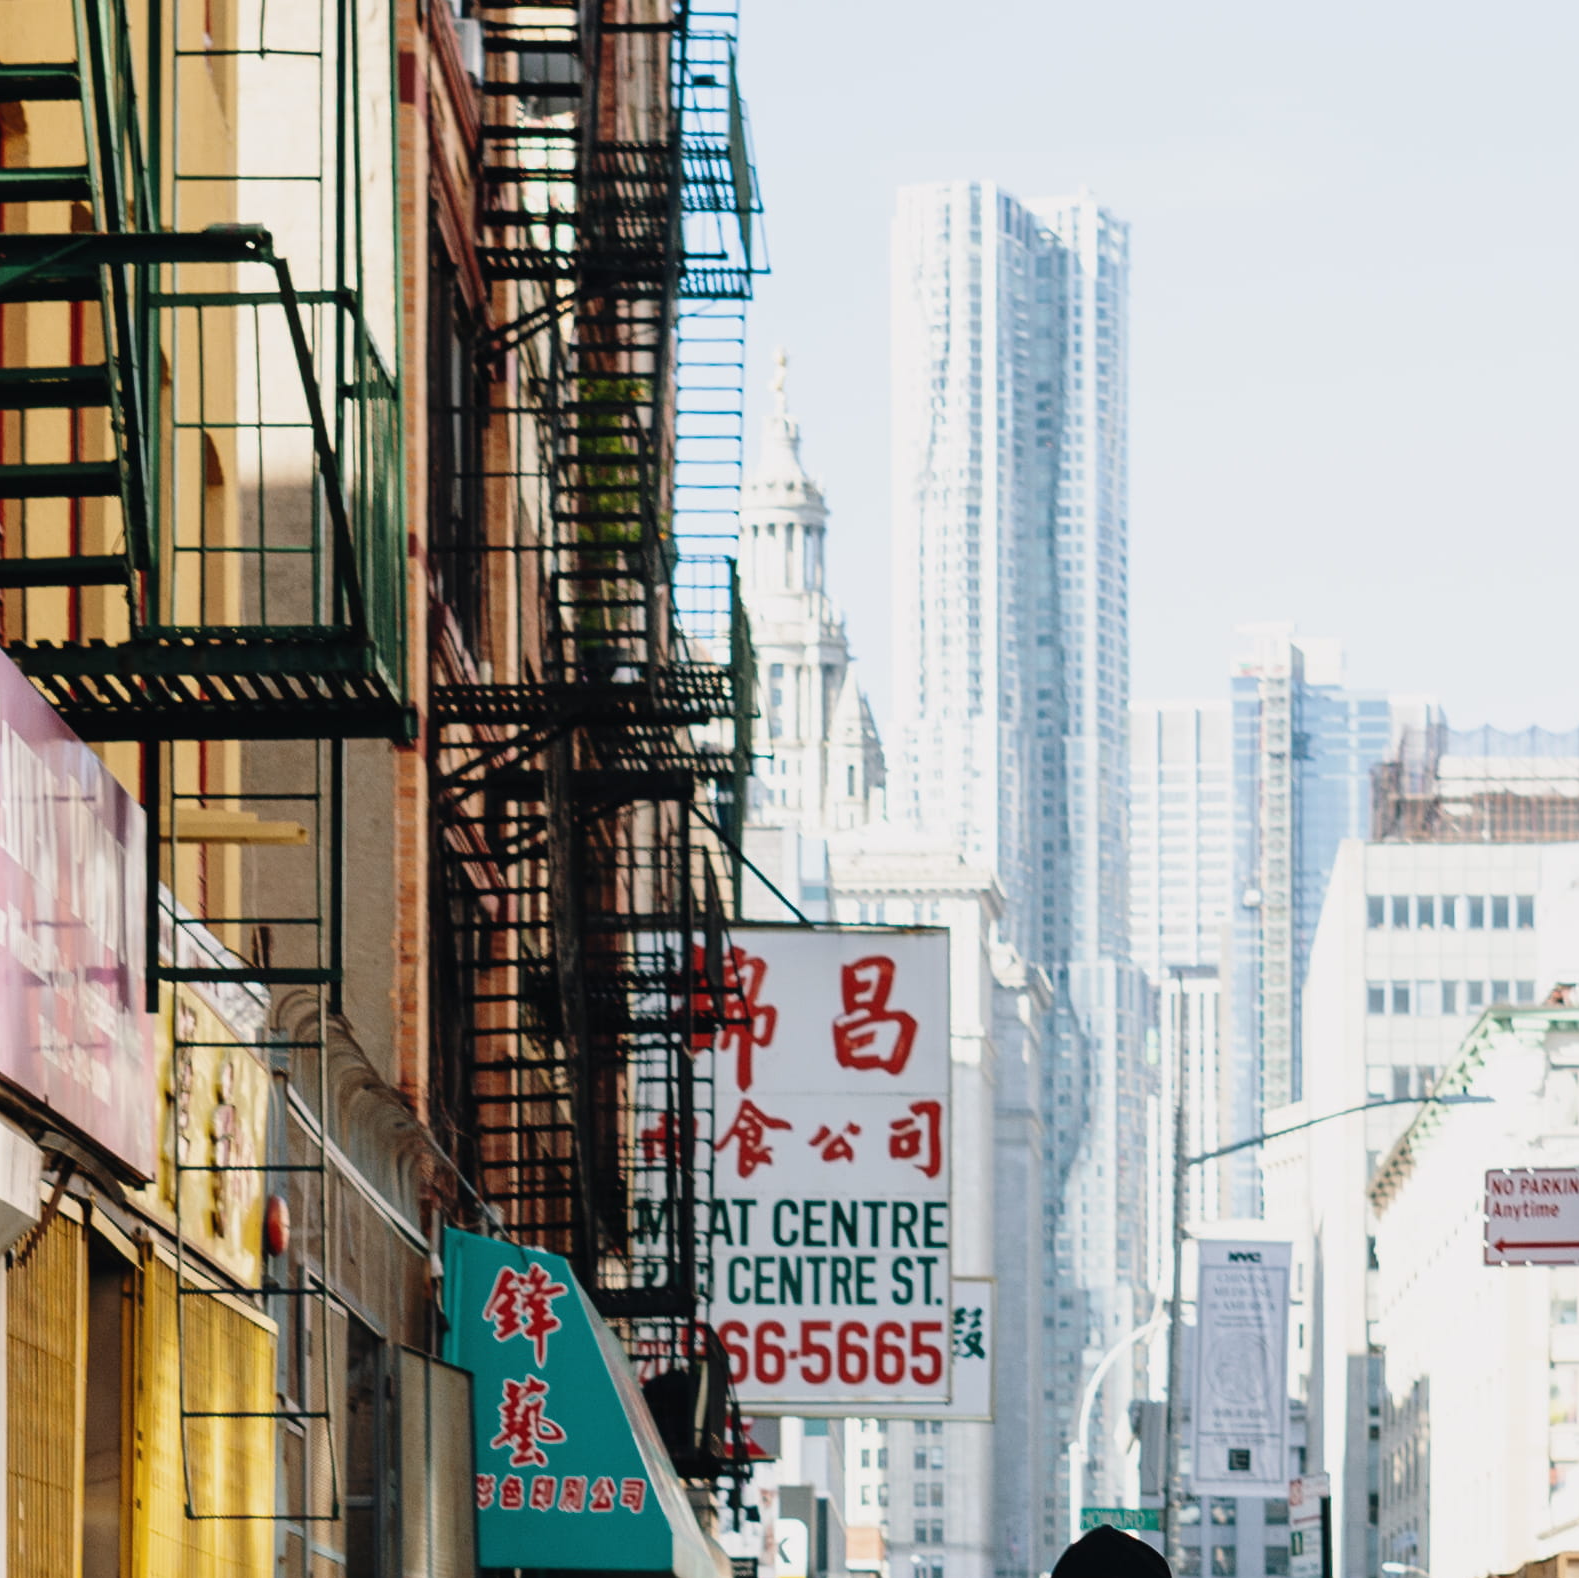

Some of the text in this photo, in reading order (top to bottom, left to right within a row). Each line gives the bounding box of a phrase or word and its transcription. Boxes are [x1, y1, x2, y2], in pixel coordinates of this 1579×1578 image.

[1491, 1178, 1515, 1196] NO
[1492, 1202, 1561, 1221] Anytime
[772, 1200, 949, 1250] CENTRE
[1228, 1251, 1262, 1264] NYC
[727, 1256, 878, 1308] CENTRE
[890, 1257, 944, 1307] ST.
